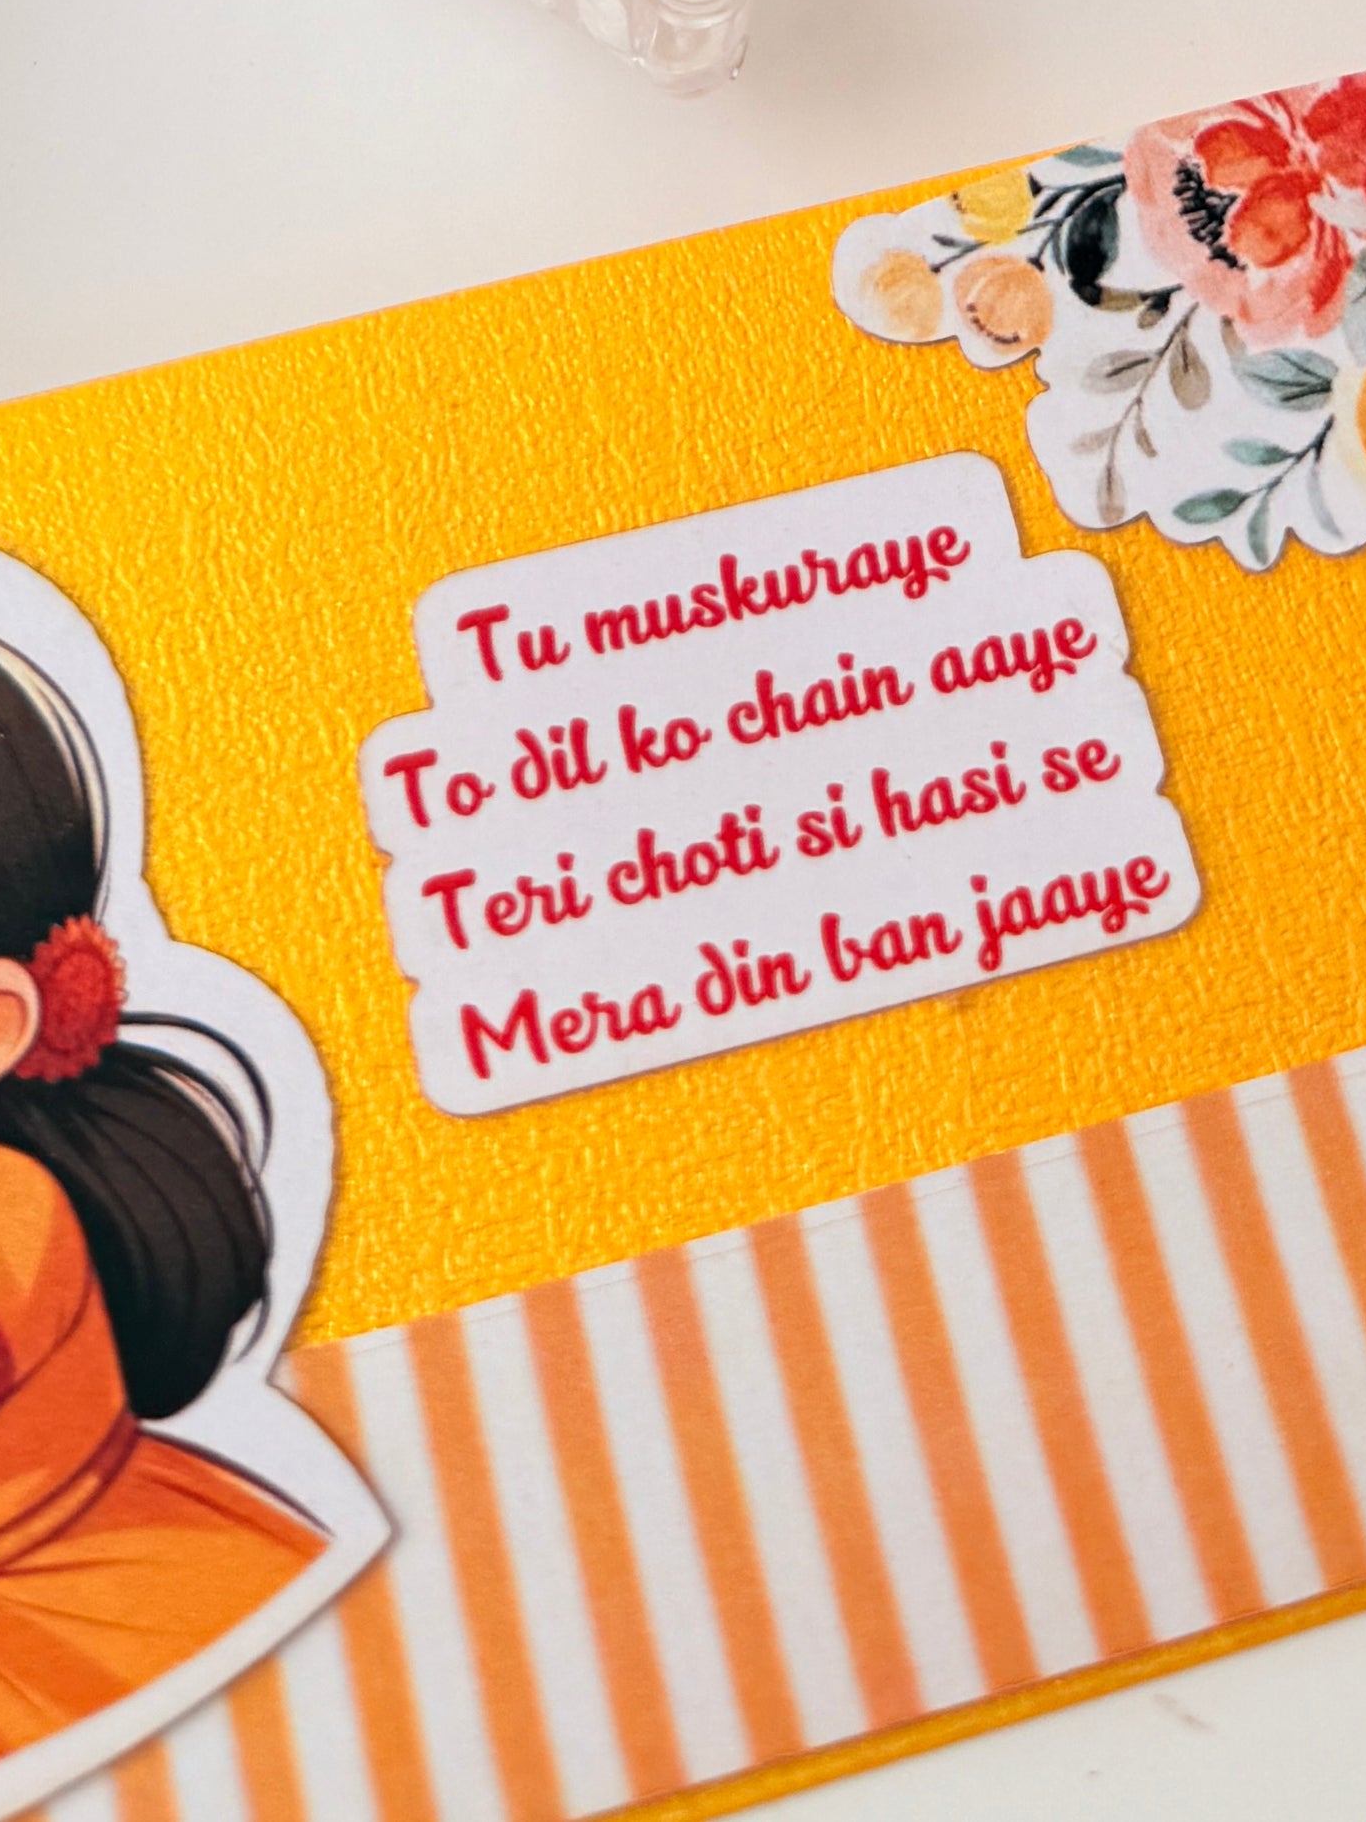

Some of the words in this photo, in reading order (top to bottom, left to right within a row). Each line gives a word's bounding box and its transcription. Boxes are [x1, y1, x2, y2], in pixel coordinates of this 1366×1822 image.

[454, 603, 572, 684] Tu
[582, 523, 973, 656] muskuraye
[381, 748, 497, 830] To
[508, 717, 609, 803] dil
[616, 703, 714, 776] ko
[725, 651, 917, 747] chain
[928, 616, 1100, 697] aaye
[419, 852, 595, 952] Teri
[605, 803, 782, 908] choti
[794, 782, 865, 860] si
[869, 739, 1028, 841] hasi
[1040, 738, 1123, 796] se
[458, 983, 684, 1082] Mera
[693, 938, 814, 1019] din
[818, 911, 965, 985] ban
[969, 855, 1172, 973] jaaye
